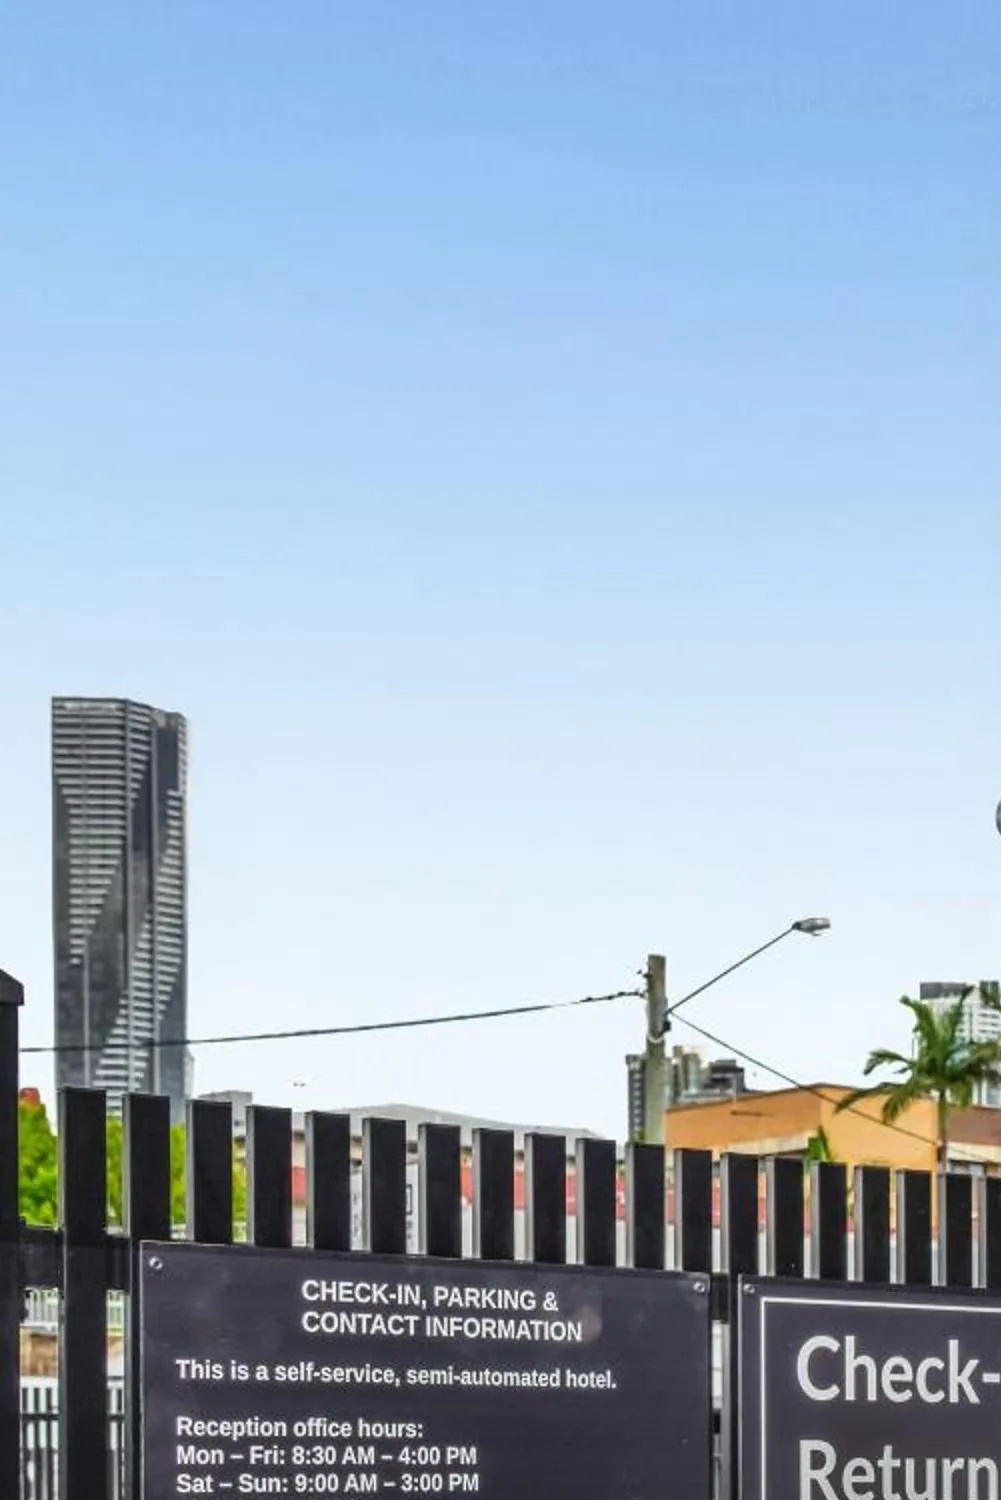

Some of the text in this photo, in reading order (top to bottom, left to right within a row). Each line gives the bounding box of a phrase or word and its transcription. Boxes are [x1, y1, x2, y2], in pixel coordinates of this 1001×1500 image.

[300, 1278, 559, 1311] CHECK-IN, PARKING &
[301, 1310, 582, 1341] CONTACT INFORMATION
[174, 1358, 617, 1388] This is a self-service, semi-automated hotel.
[175, 1415, 423, 1441] Reception office hours:
[175, 1444, 224, 1465] Mon
[248, 1444, 285, 1464] Fri:
[291, 1444, 337, 1465] 8:30
[340, 1445, 375, 1465] AM
[397, 1445, 440, 1465] 4:00
[445, 1445, 477, 1465] PM
[175, 1472, 214, 1493] Sat
[237, 1472, 288, 1493] Sun:
[293, 1472, 339, 1492] 9:00
[343, 1472, 377, 1492] AM
[399, 1472, 443, 1492] 3:00
[447, 1472, 479, 1491] PM
